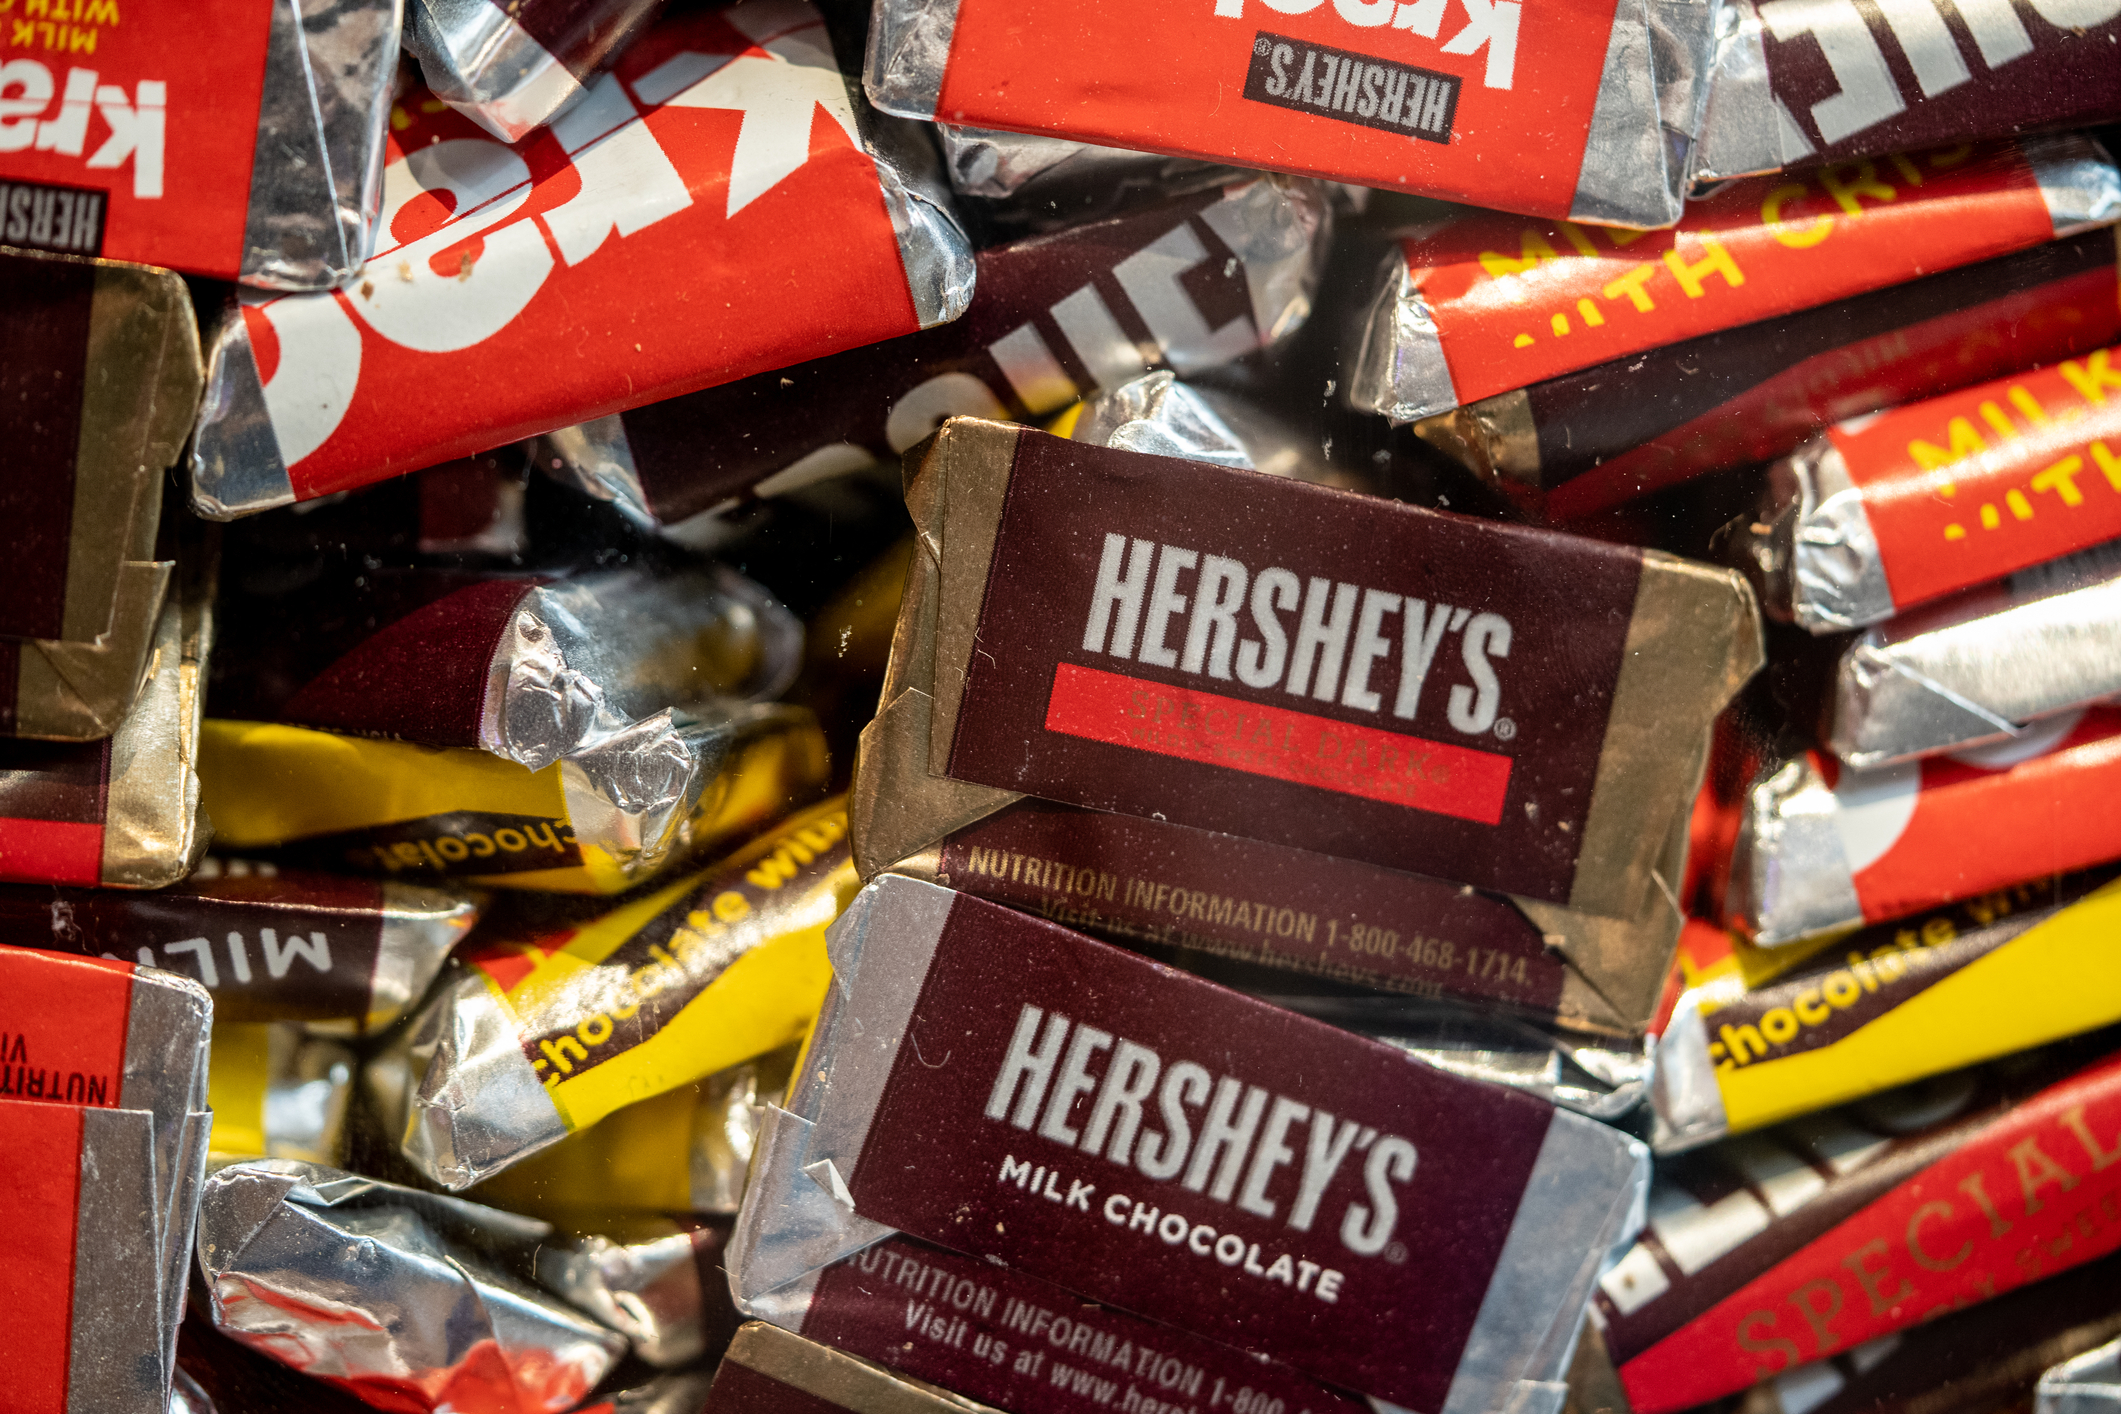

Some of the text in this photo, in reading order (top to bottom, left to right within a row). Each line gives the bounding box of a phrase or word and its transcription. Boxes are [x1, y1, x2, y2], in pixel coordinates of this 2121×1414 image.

[11, 18, 98, 54] MILK
[1264, 42, 1452, 134] HERSHEY'S
[1082, 532, 1512, 737] HERSHEY'S
[1126, 689, 1434, 781] SPECIAL DARK
[967, 845, 1118, 902] NUTRITION
[1125, 876, 1317, 943] INFORMATION
[101, 927, 334, 989] MIL
[984, 1002, 1418, 1256] HERSHEY'S
[998, 1155, 1346, 1302] MILK CHOCOLATE
[850, 1246, 998, 1319] UTRITION
[1001, 1297, 1204, 1397] INFORMATION
[905, 1300, 968, 1349] Visit
[972, 1332, 1008, 1365] us
[1013, 1349, 1046, 1378] at
